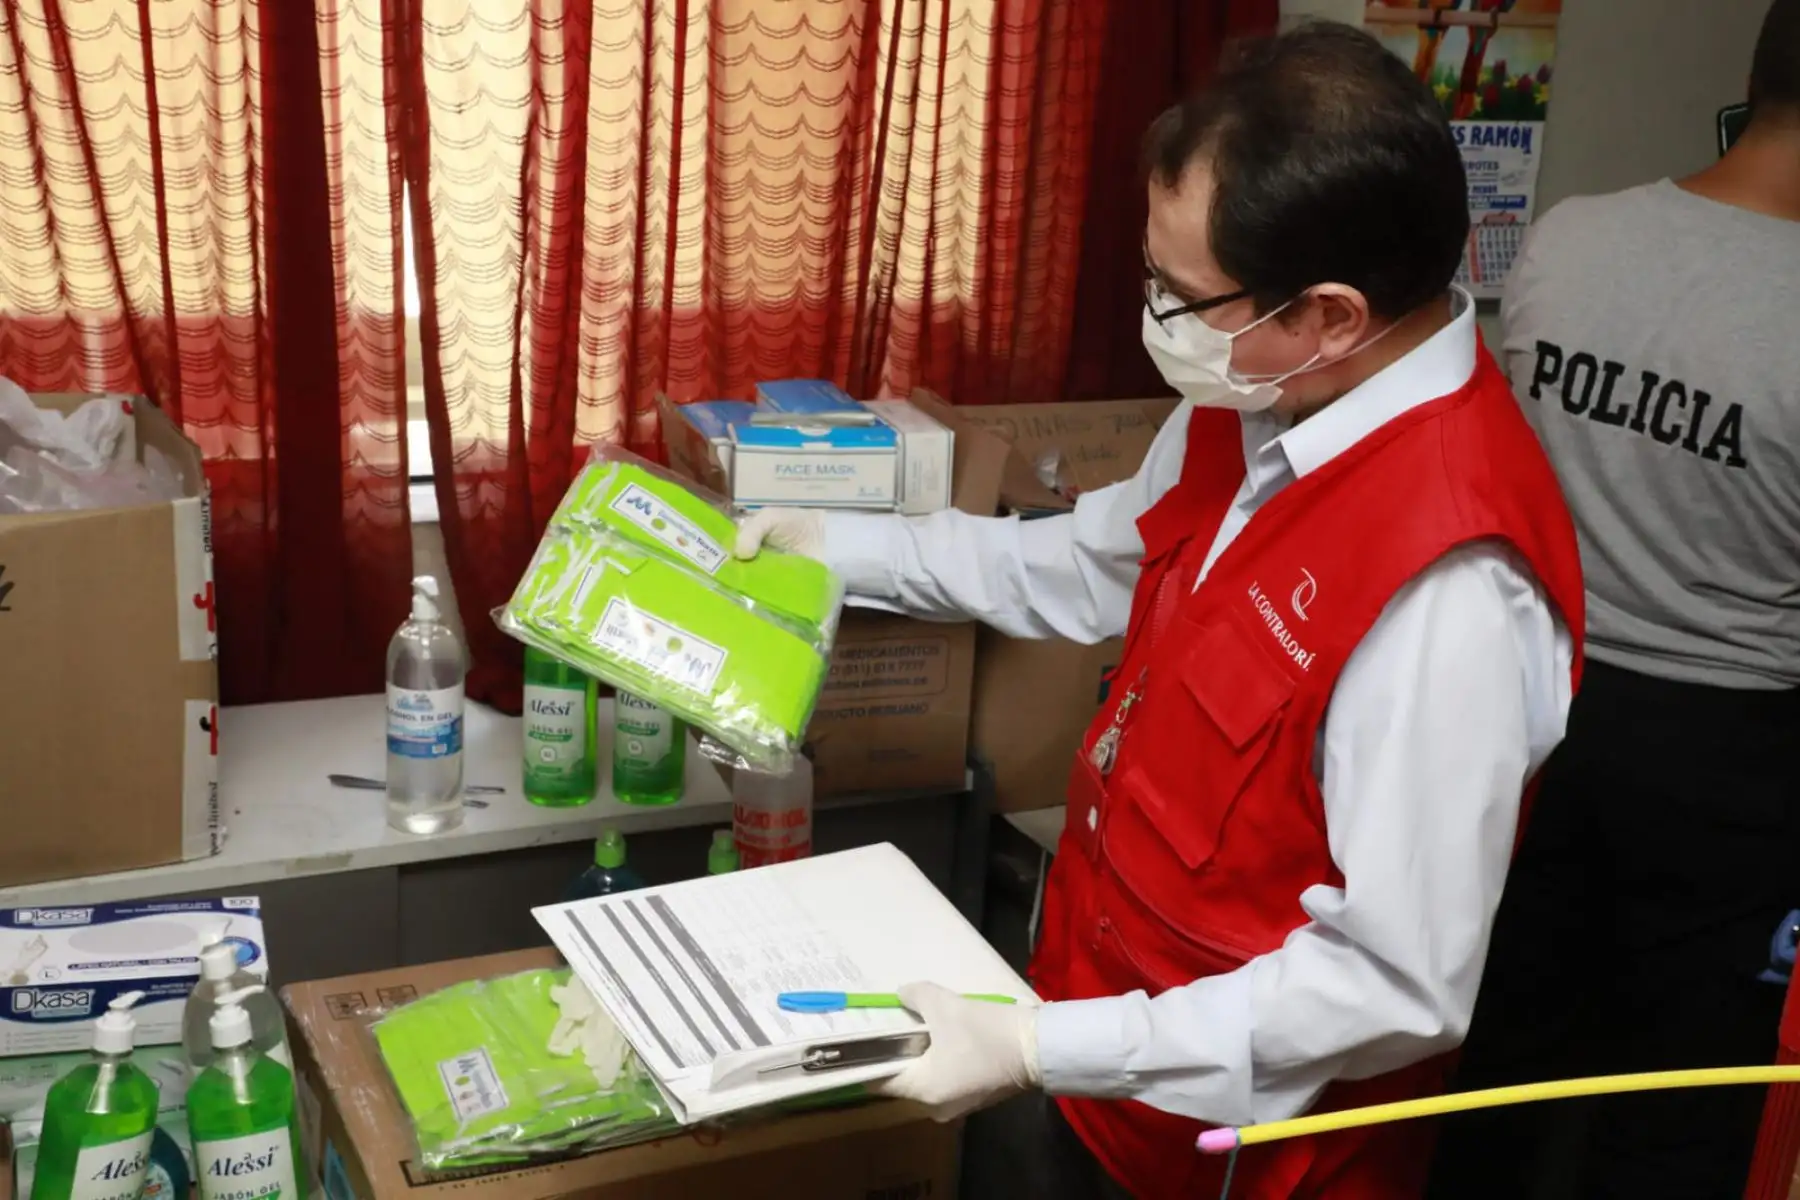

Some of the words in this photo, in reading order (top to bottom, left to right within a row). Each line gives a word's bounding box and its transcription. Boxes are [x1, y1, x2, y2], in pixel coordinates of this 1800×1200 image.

[1529, 339, 1748, 469] POLICIA
[775, 464, 812, 475] FACE
[816, 464, 856, 475] MASK
[1254, 594, 1317, 672] CONTRALORÍ
[15, 908, 91, 923] Dkasa
[14, 988, 91, 1012] Dkasa
[206, 1145, 274, 1177] Alessi
